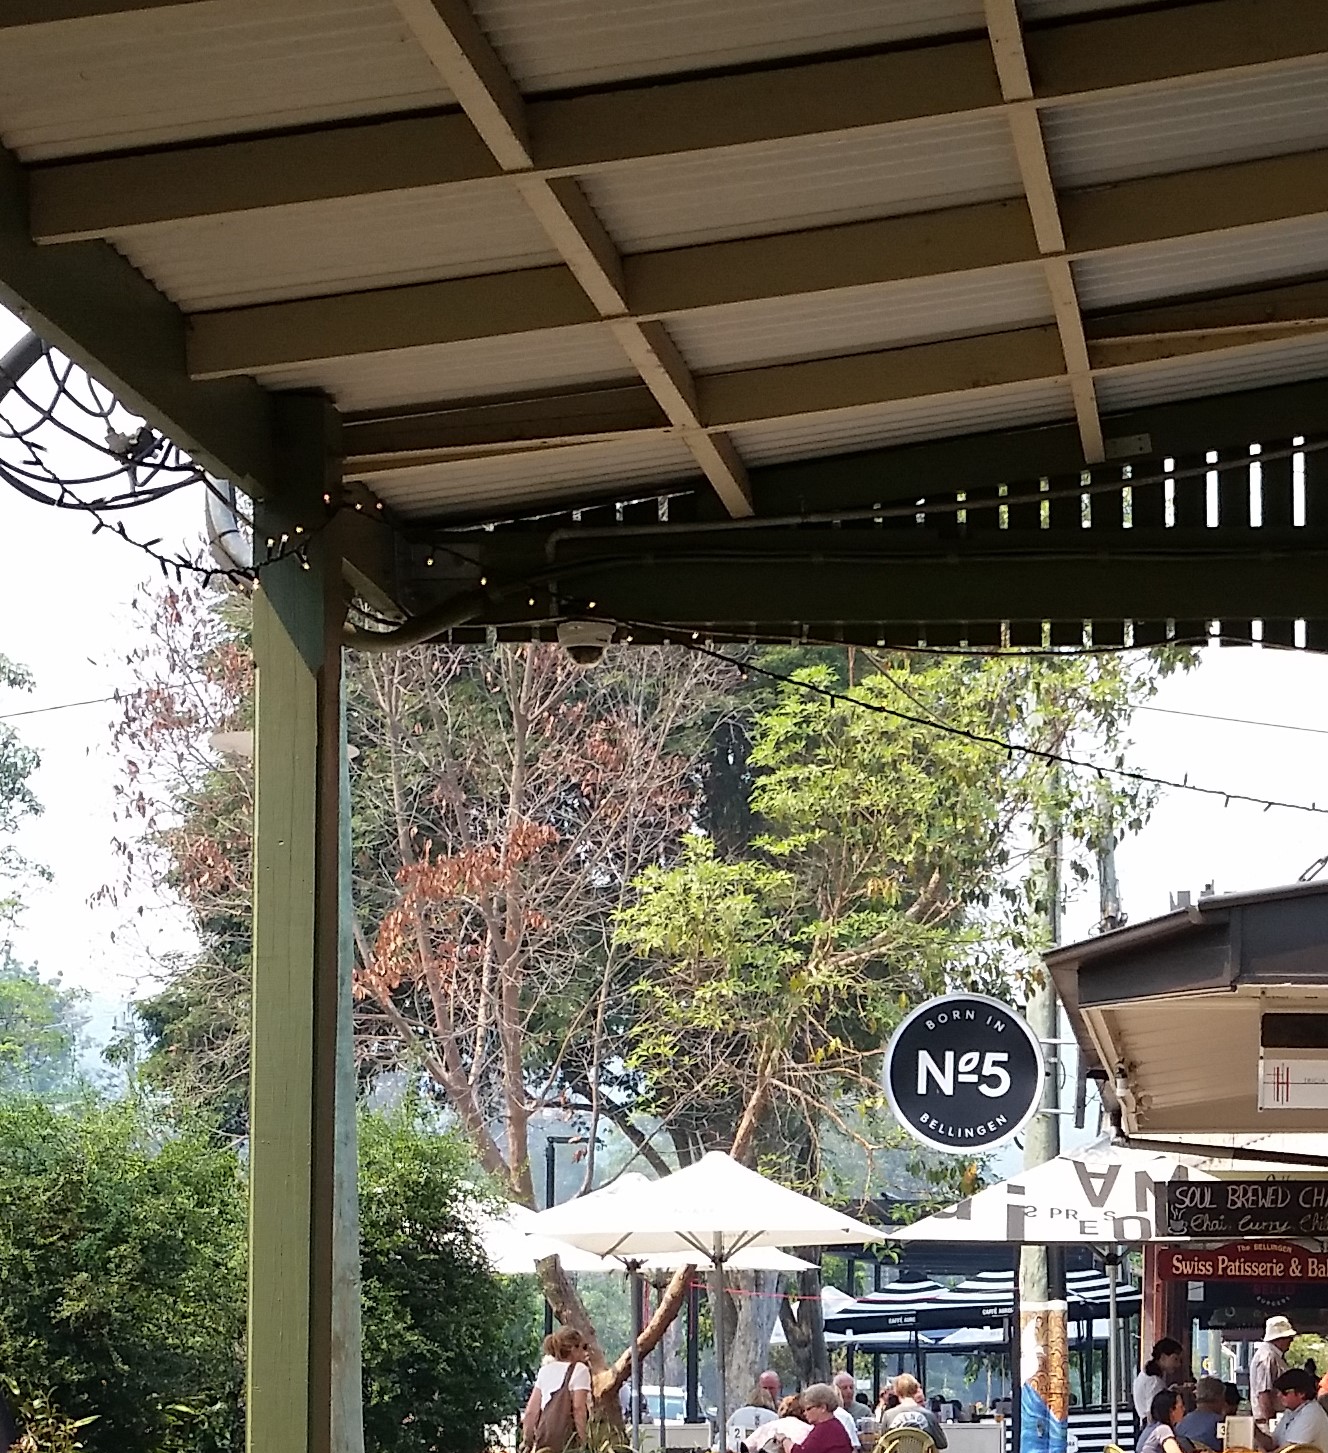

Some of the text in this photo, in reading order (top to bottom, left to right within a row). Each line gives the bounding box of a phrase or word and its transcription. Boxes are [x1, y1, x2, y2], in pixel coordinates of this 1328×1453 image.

[925, 1010, 1006, 1032] BORN IN
[919, 1112, 1008, 1138] BELLINGEN
[1175, 1186, 1217, 1209] SOUL
[1227, 1185, 1291, 1209] BREWED
[1237, 1243, 1292, 1254] The BELLINGEN
[1172, 1254, 1213, 1275] Swiss
[1217, 1255, 1284, 1277] Patisserie
[1289, 1257, 1303, 1277] &
[734, 1428, 741, 1439] 2
